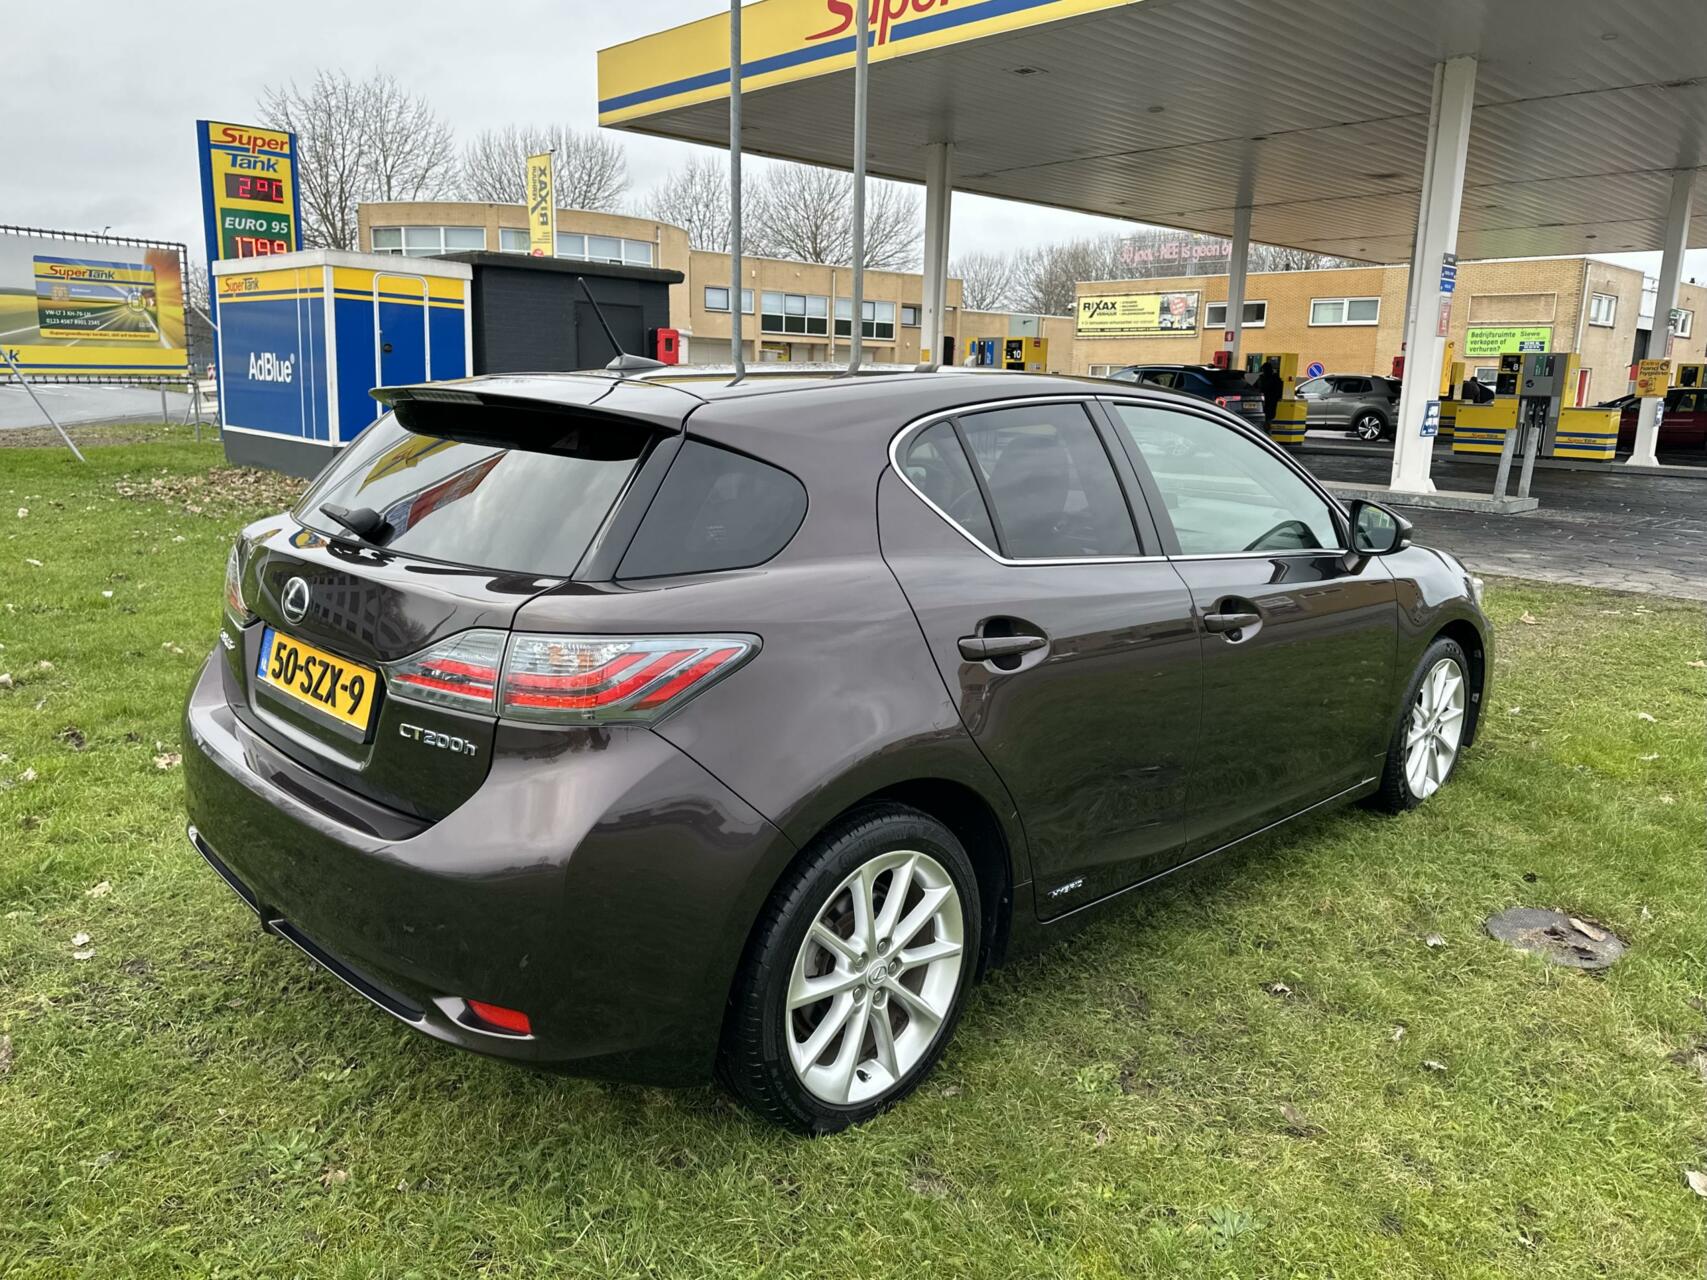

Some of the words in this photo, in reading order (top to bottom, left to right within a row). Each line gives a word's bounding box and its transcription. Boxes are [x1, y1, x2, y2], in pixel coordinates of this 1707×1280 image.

[210, 126, 289, 154] Super
[224, 152, 279, 173] Tank
[224, 216, 267, 232] EURO
[271, 221, 288, 234] 95
[45, 264, 115, 281] SuperTank
[223, 277, 259, 297] SuperTank
[1082, 299, 1117, 318] RIXAX
[1471, 331, 1516, 339] Bedrijfsruimte
[1012, 350, 1021, 359] 10
[1469, 345, 1501, 353] verhuren?
[1513, 363, 1519, 371] 8
[271, 641, 365, 716] 50-SZX-9
[399, 722, 478, 757] CT200h
